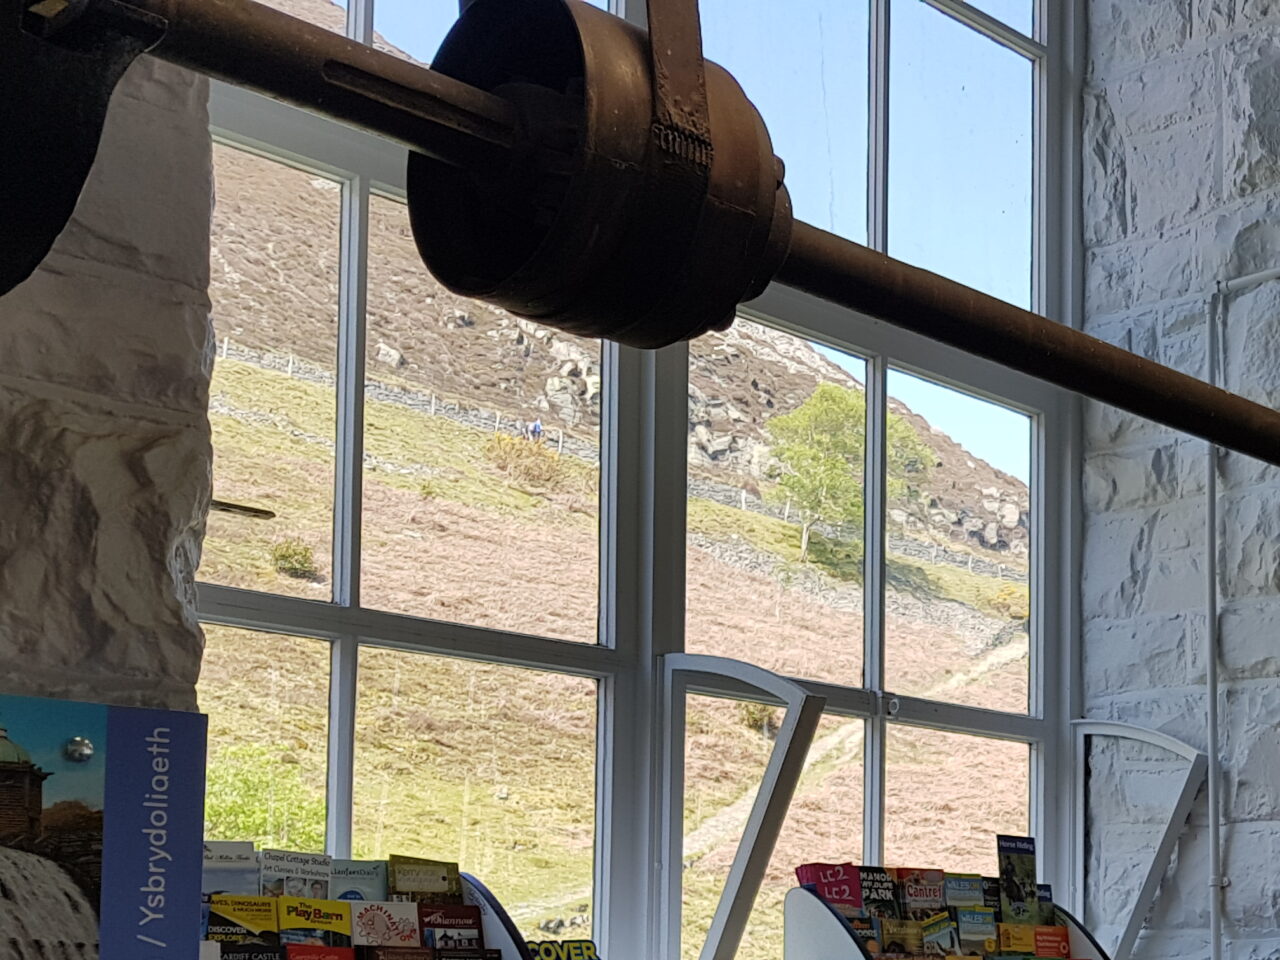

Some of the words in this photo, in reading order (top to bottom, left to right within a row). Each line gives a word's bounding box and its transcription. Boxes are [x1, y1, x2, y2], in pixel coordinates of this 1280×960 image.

[139, 727, 171, 926] Ysbrydoliaeth
[1000, 841, 1016, 849] Horse
[1016, 842, 1034, 852] Riding
[264, 852, 285, 864] Chapel
[286, 854, 311, 867] Cottage
[311, 856, 331, 867] Studio
[820, 865, 849, 883] LC2
[825, 885, 856, 900] LC2
[862, 888, 894, 901] PARK
[907, 884, 942, 901] Cantref
[287, 906, 311, 921] Play
[313, 910, 344, 921] Barn
[430, 914, 473, 925] Rhiannon
[961, 914, 983, 923] WALES
[357, 904, 417, 942] MACHINATIONS
[208, 926, 247, 935] DISCOVER
[137, 933, 166, 947] /
[252, 953, 280, 960] CASTLE
